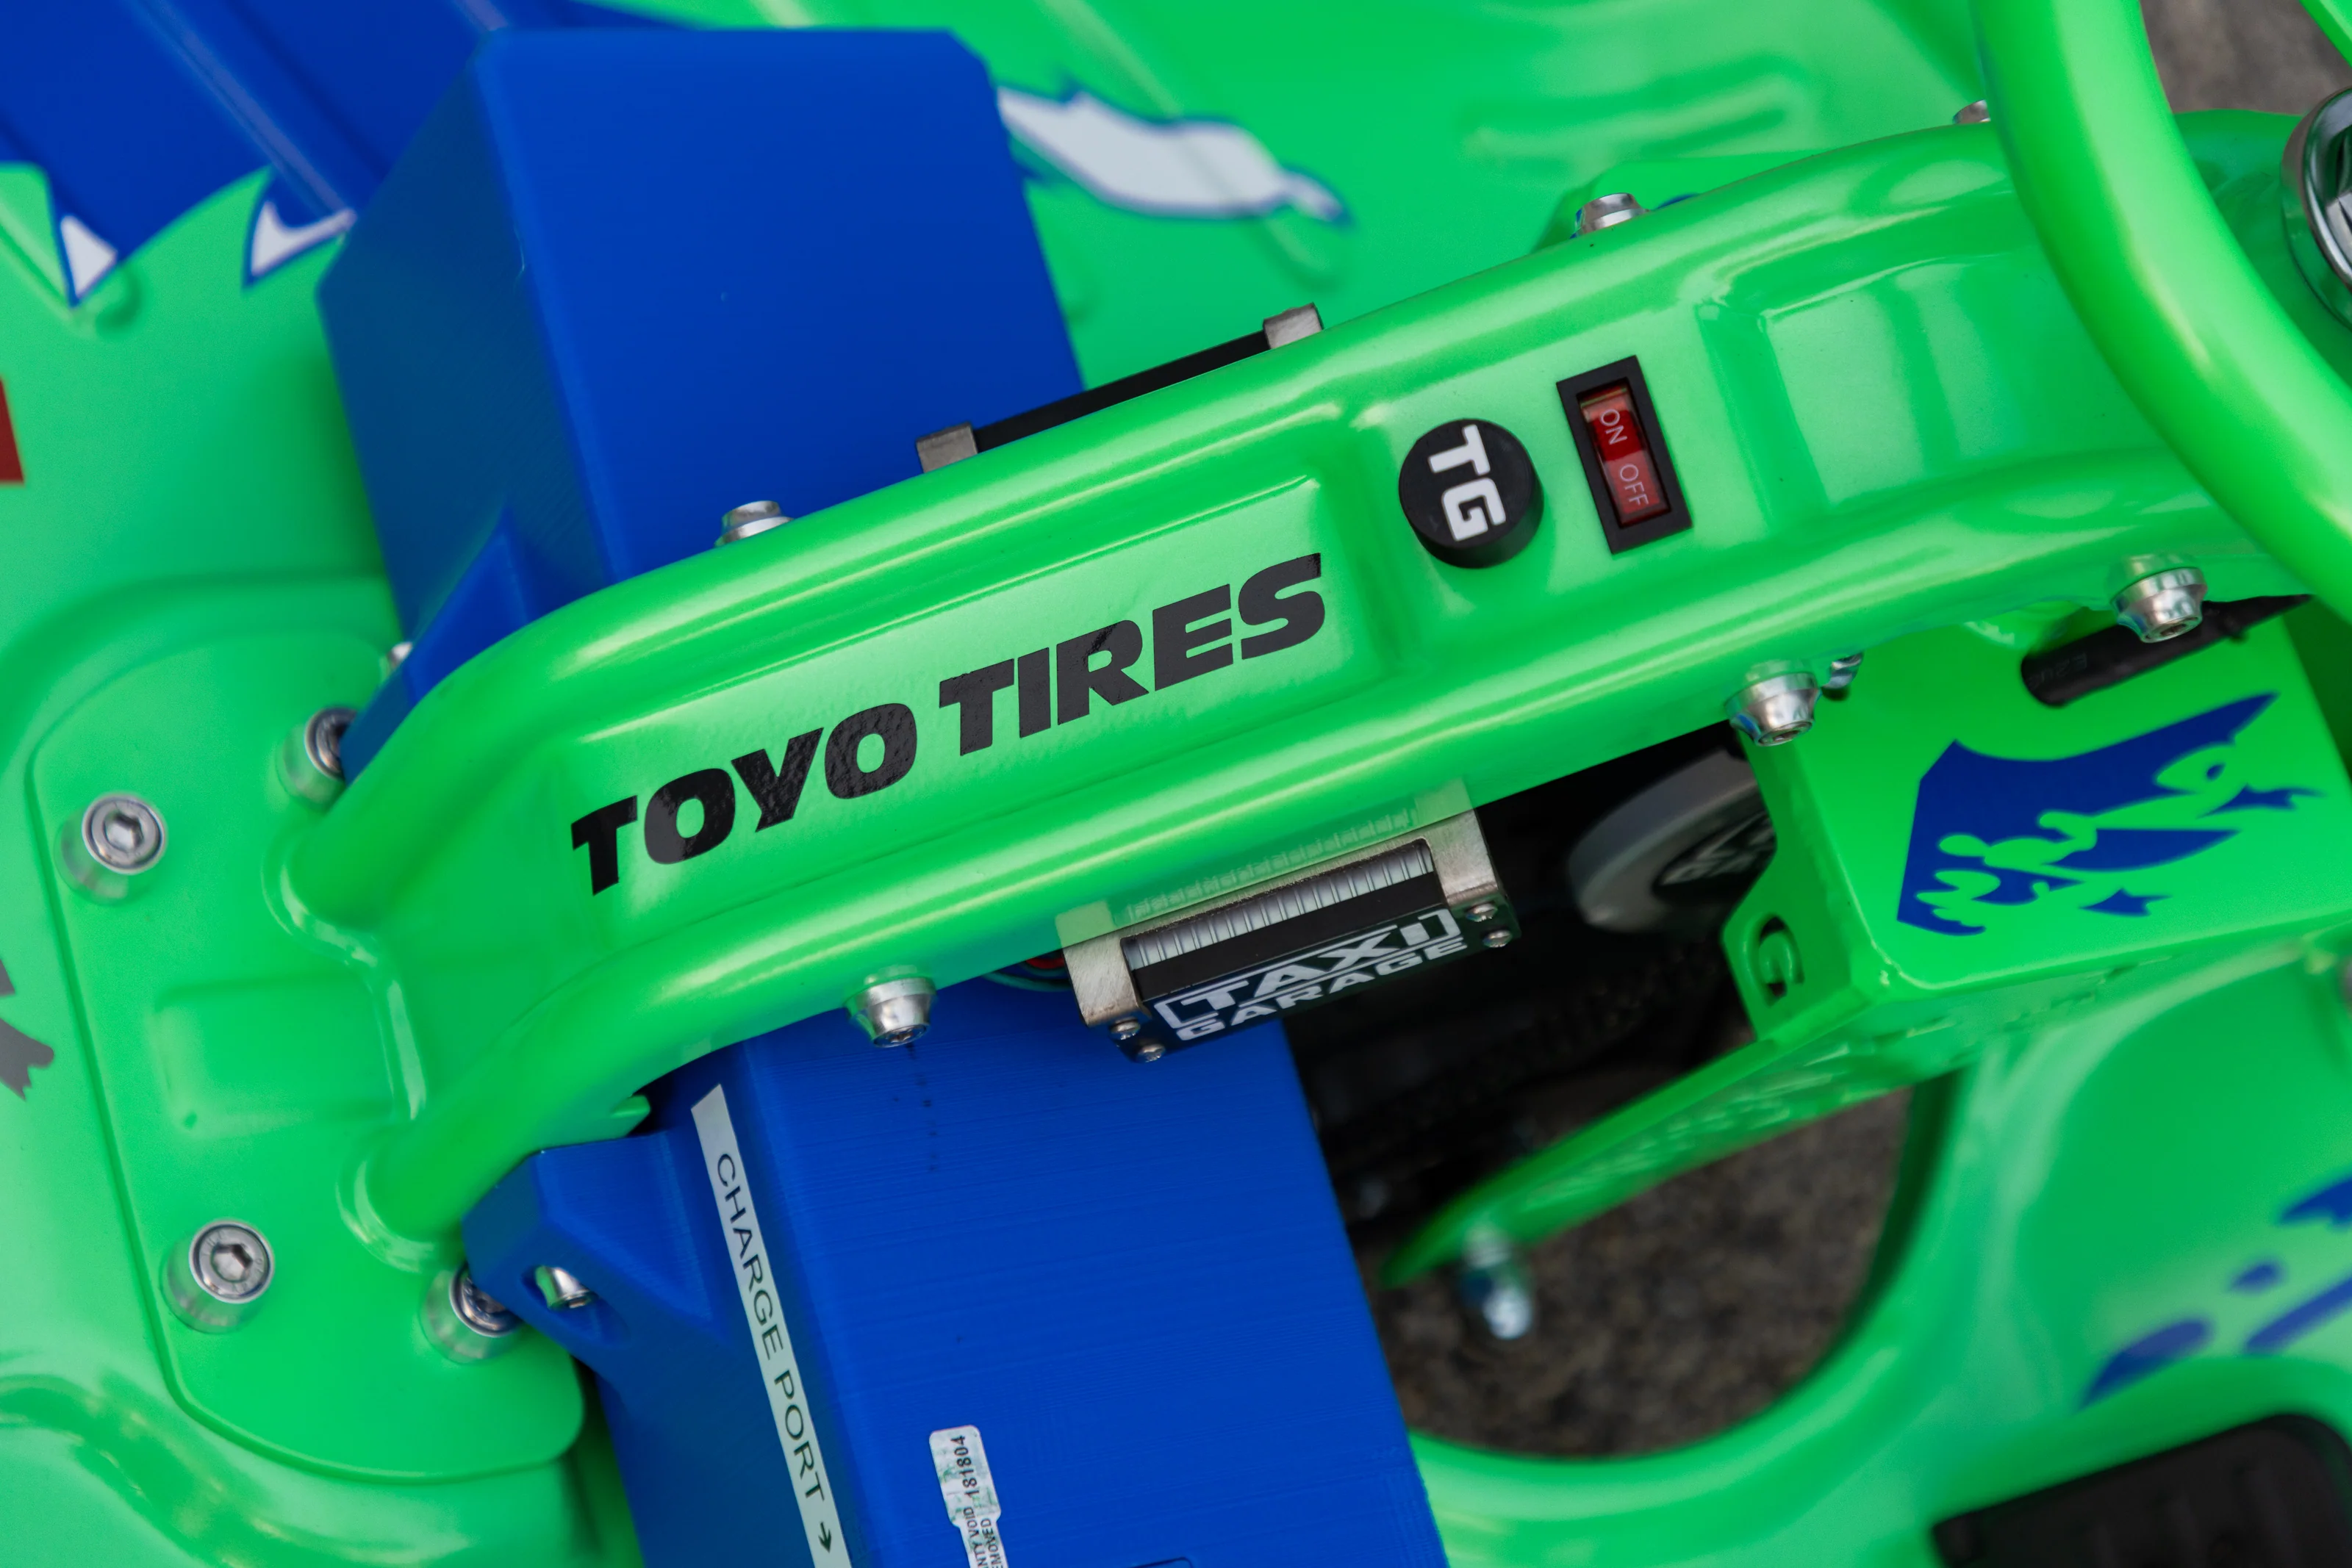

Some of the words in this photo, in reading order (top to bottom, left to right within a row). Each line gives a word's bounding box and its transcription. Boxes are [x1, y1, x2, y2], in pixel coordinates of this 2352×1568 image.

[1601, 409, 1628, 445] ON
[1428, 424, 1507, 542] TG
[1619, 464, 1649, 506] OFF
[571, 703, 917, 895] TOYO
[938, 552, 1325, 755] TIRES
[1177, 935, 1467, 1040] GARAGE
[717, 1154, 784, 1360] CHARGE
[774, 1370, 825, 1501] PORT
[950, 1435, 980, 1498] 181804
[964, 1506, 979, 1538] VOID
[972, 1541, 989, 1568] NTY
